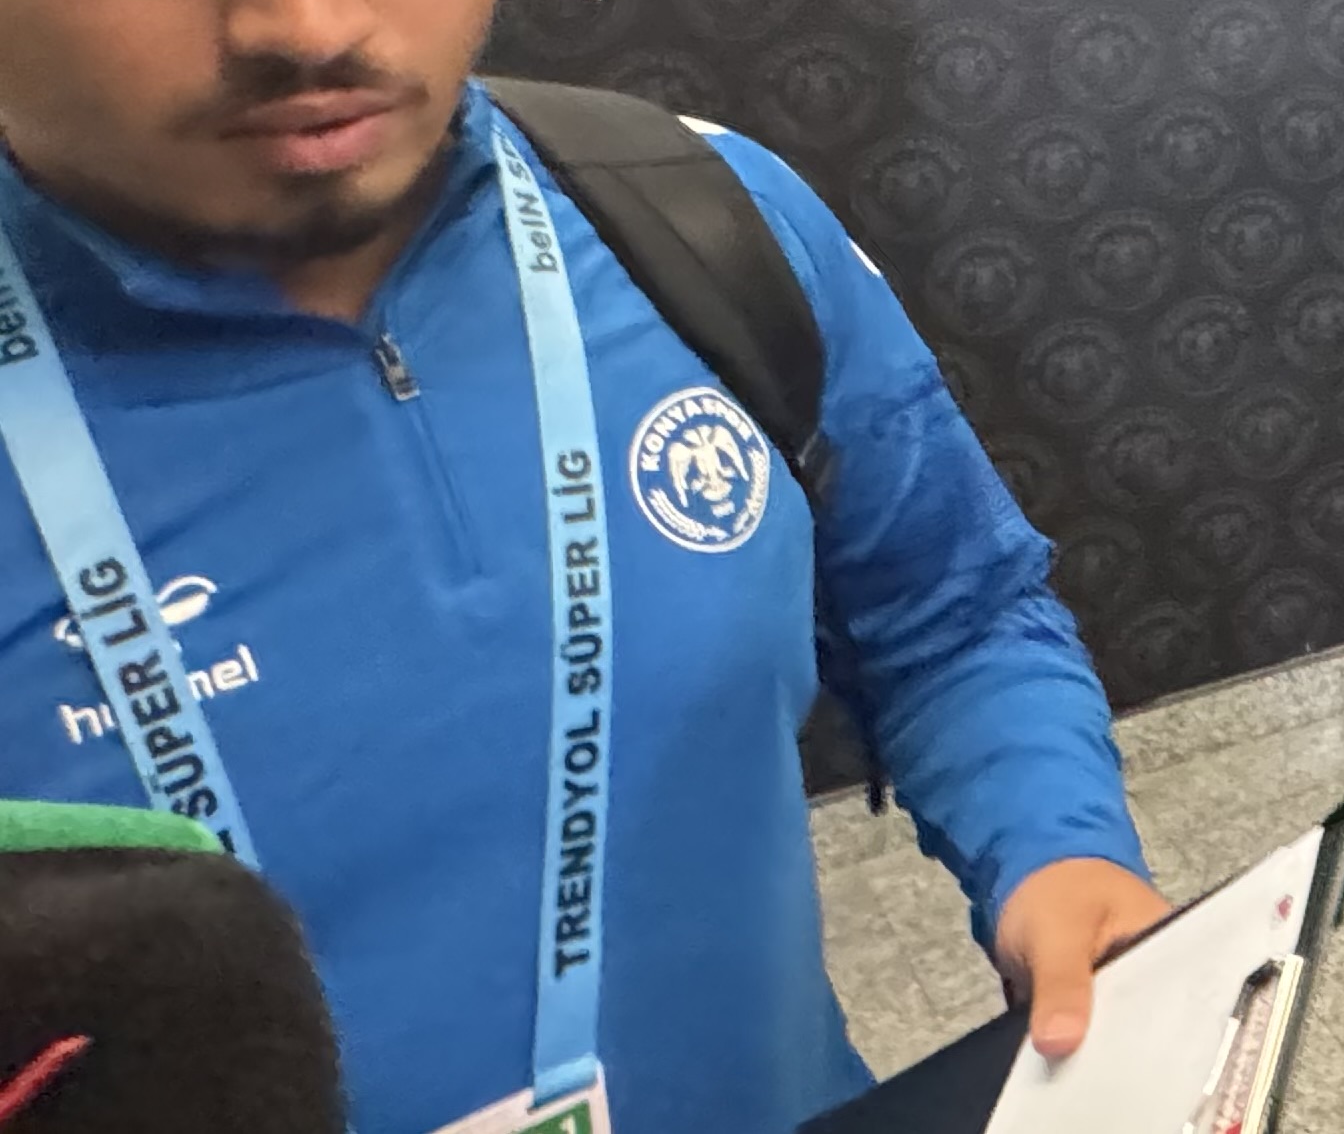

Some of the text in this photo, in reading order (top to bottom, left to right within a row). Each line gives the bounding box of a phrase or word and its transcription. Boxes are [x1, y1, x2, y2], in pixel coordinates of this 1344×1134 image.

[551, 449, 603, 981] TRENDYOL SÜPER LİG
